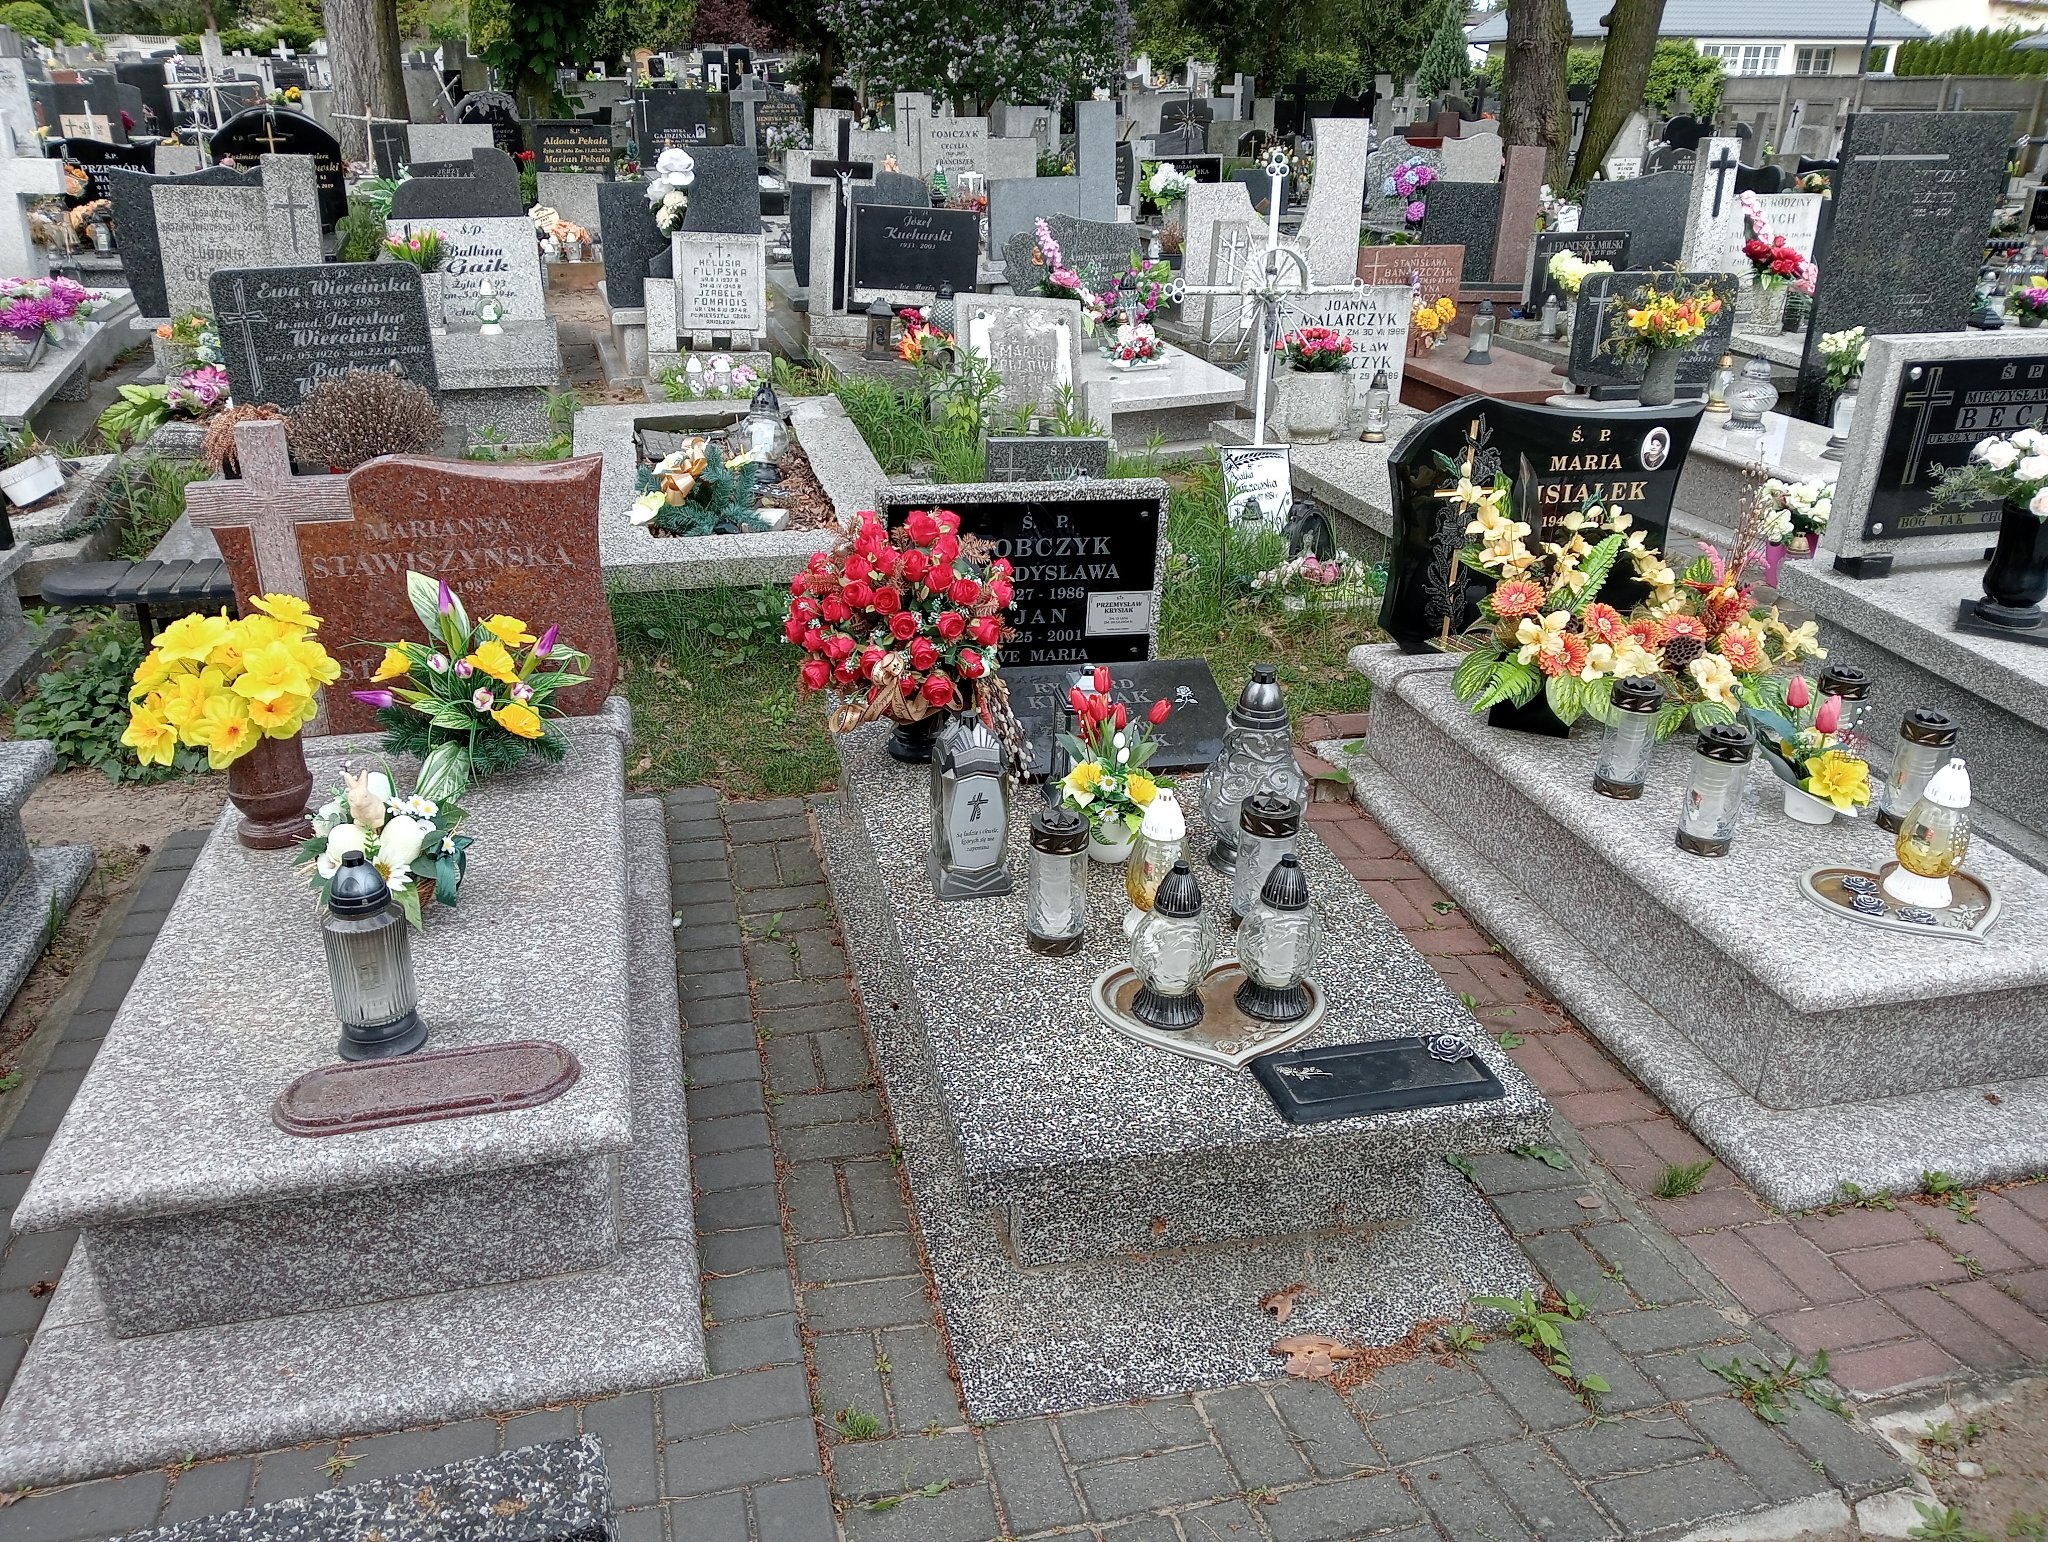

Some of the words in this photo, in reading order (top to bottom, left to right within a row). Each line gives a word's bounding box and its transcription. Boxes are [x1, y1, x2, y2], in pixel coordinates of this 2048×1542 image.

[543, 136, 576, 145] Aldona
[931, 130, 979, 138] TOMCZYK
[544, 155, 577, 163] Marian
[1770, 198, 1812, 208] RODZINY
[903, 214, 934, 228] Józef
[882, 225, 954, 242] Kucharski
[448, 244, 503, 257] Balbina
[1554, 240, 1596, 250] FRANCISZEK
[1597, 240, 1624, 249] MOLSKI
[445, 257, 510, 276] Gaik
[699, 258, 742, 267] HELUSIA
[693, 268, 748, 277] FILIPSKA
[256, 281, 300, 298] Ewa
[307, 276, 413, 297] Wiercińska
[1324, 299, 1378, 312] JOANNA
[1300, 312, 1398, 327] MALARCZYK
[287, 325, 399, 346] Wierciński
[1346, 328, 1360, 336] ZM
[1599, 428, 1612, 442] P.
[1549, 453, 1623, 472] MARIA
[364, 516, 519, 542] MARIANNA
[1901, 517, 1928, 528] BÓG
[1938, 517, 1968, 527] TAK
[993, 536, 1112, 558] OBCZYK
[1049, 586, 1085, 600] 1986
[1013, 608, 1067, 625] JAN
[1046, 629, 1083, 642] 2001
[997, 650, 1021, 663] VE
[1030, 648, 1089, 662] MARIA
